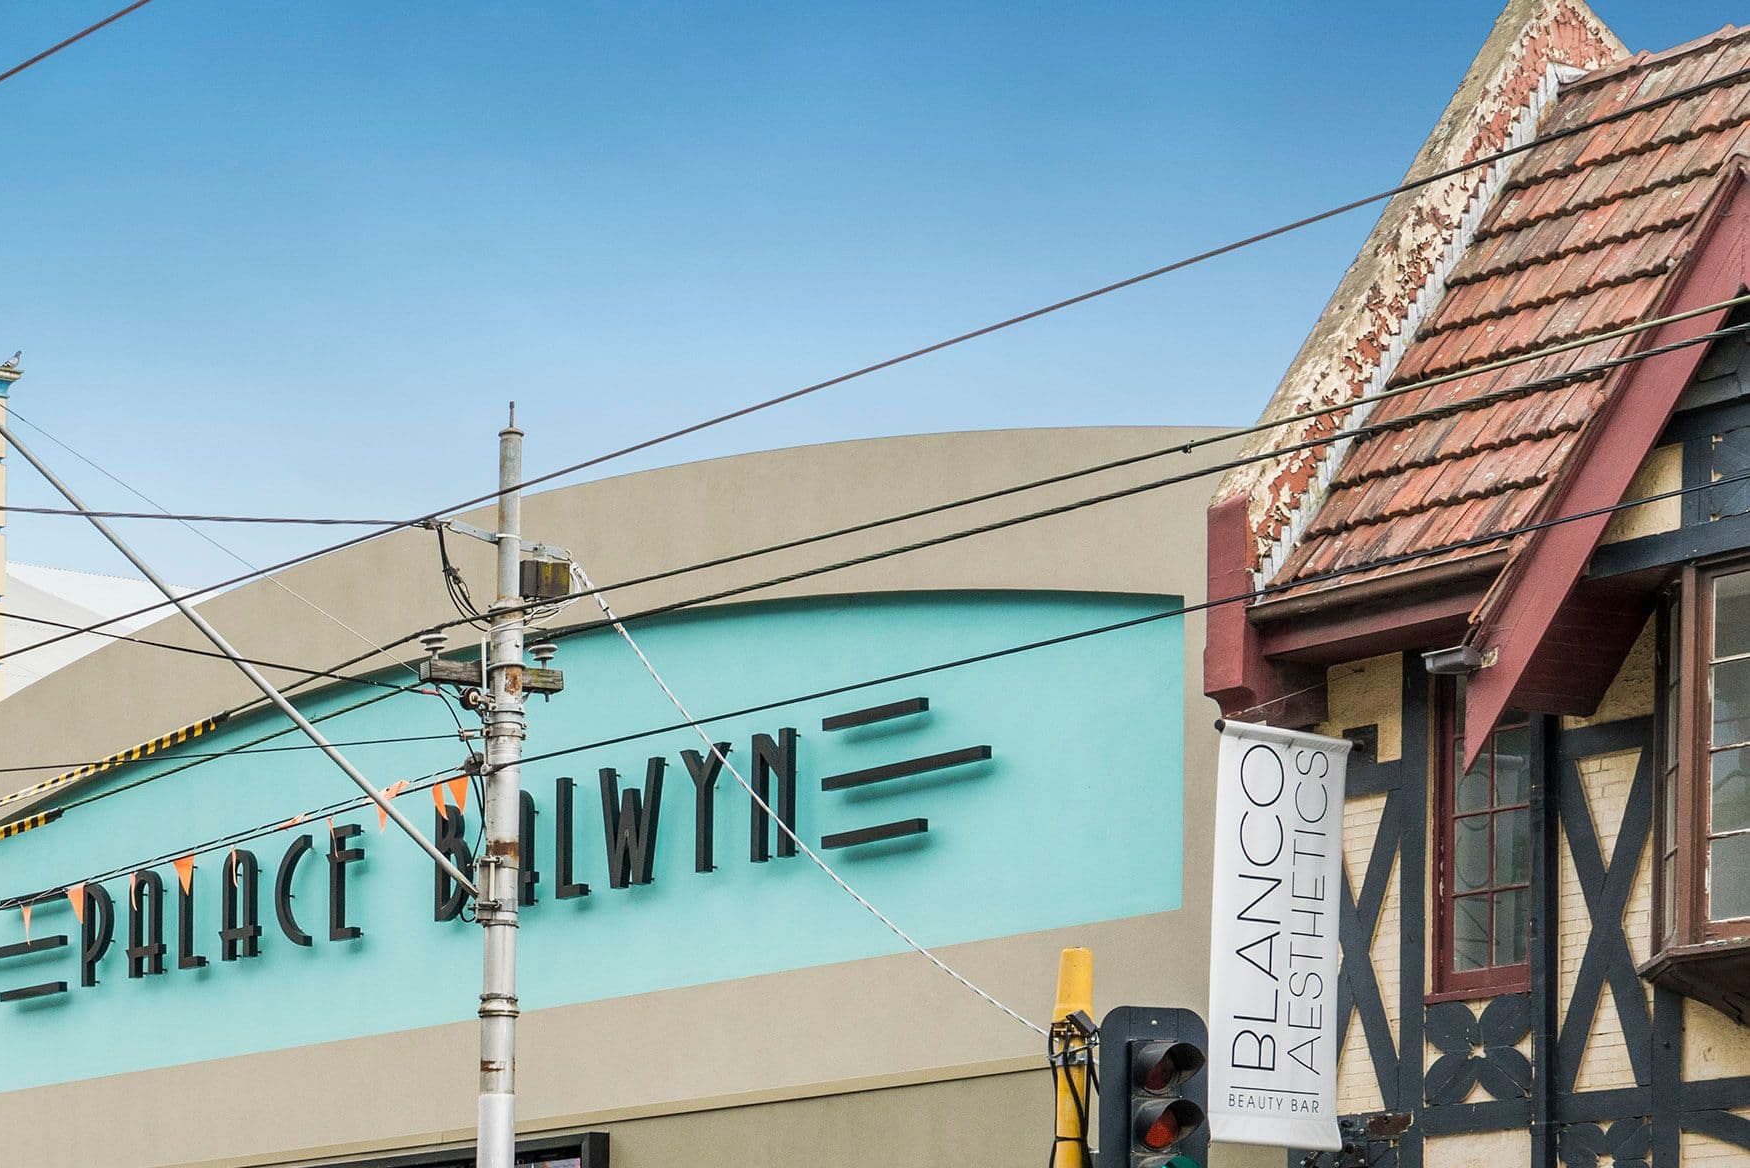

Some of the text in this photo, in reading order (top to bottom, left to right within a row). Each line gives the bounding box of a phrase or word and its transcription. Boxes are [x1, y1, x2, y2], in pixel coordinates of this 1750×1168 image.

[80, 823, 366, 988] PALACE
[1231, 742, 1285, 1072] BLANCO
[1287, 749, 1330, 1075] AESTHETICS
[1228, 1093, 1320, 1114] BEAUTY BAR
